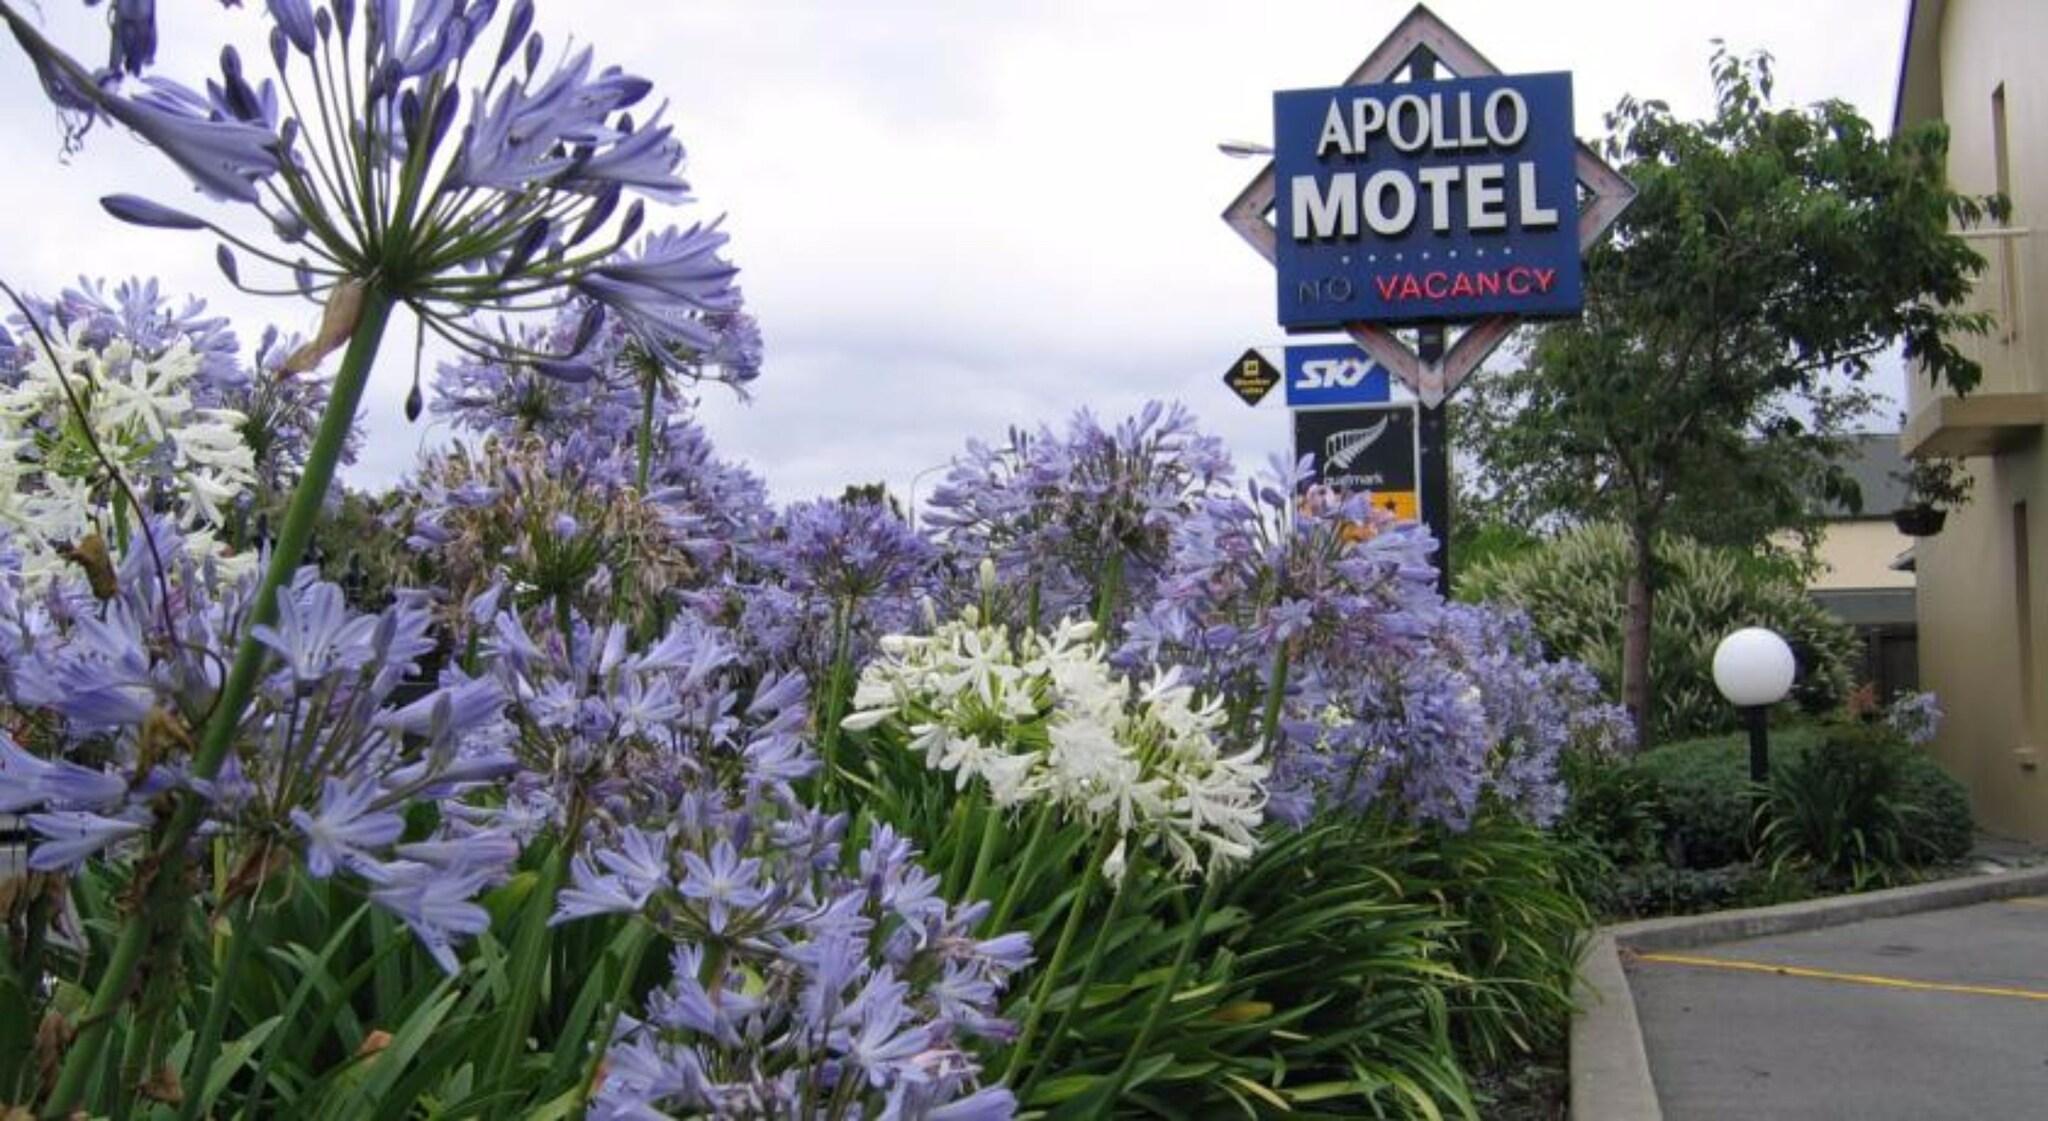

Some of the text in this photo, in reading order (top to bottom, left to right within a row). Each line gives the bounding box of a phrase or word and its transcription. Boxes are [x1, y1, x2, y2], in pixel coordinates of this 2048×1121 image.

[1317, 88, 1528, 156] APOLLO
[1291, 161, 1558, 239] MOTEL
[1299, 267, 1556, 304] NO VACANCY
[1295, 359, 1376, 389] SKY
